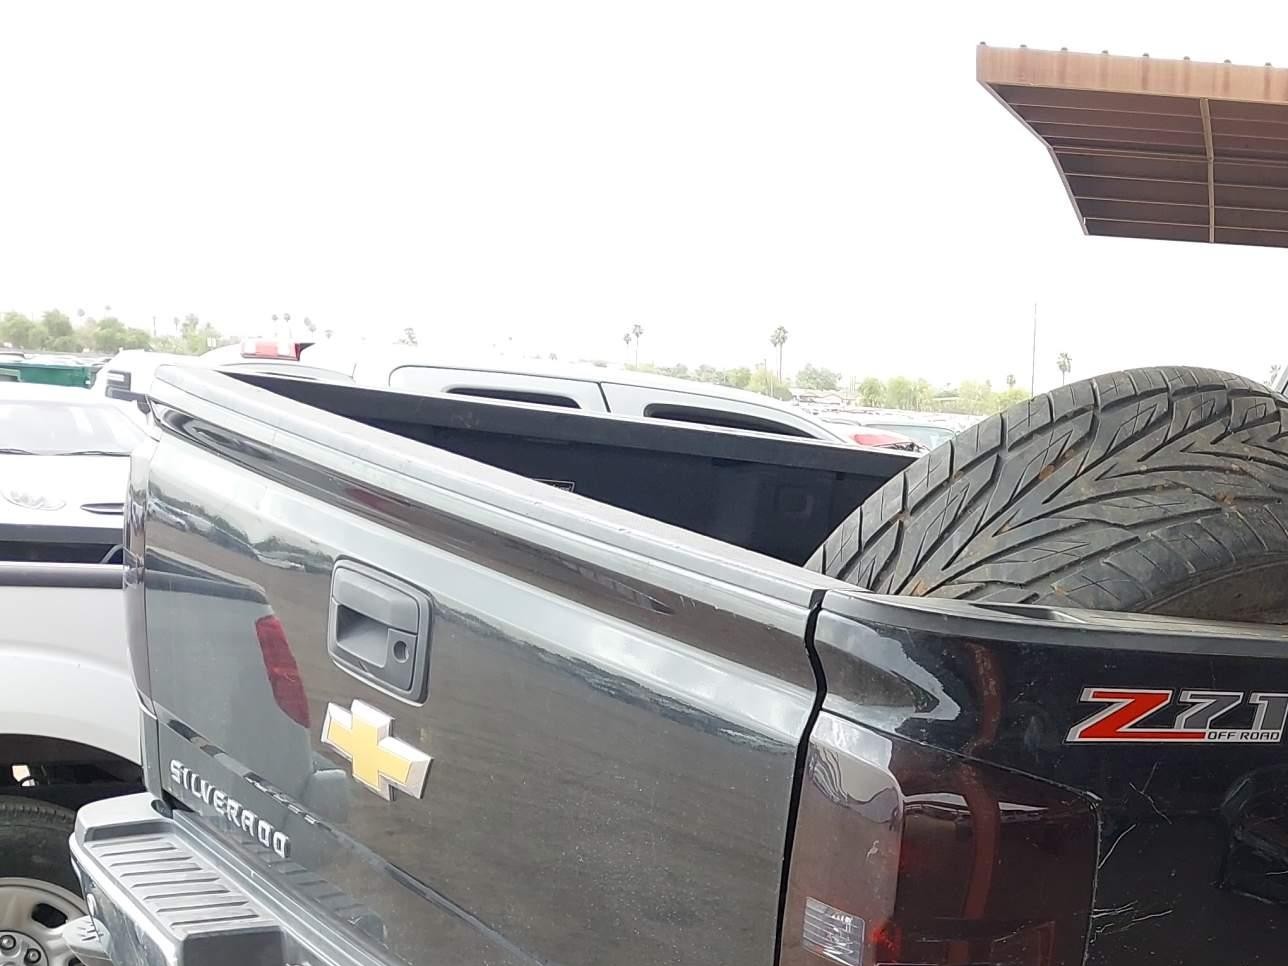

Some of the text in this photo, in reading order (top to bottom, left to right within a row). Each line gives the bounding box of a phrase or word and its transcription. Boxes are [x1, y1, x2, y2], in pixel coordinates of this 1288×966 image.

[1207, 731, 1280, 741] OFF ROAD
[169, 759, 290, 859] SILVERADO
